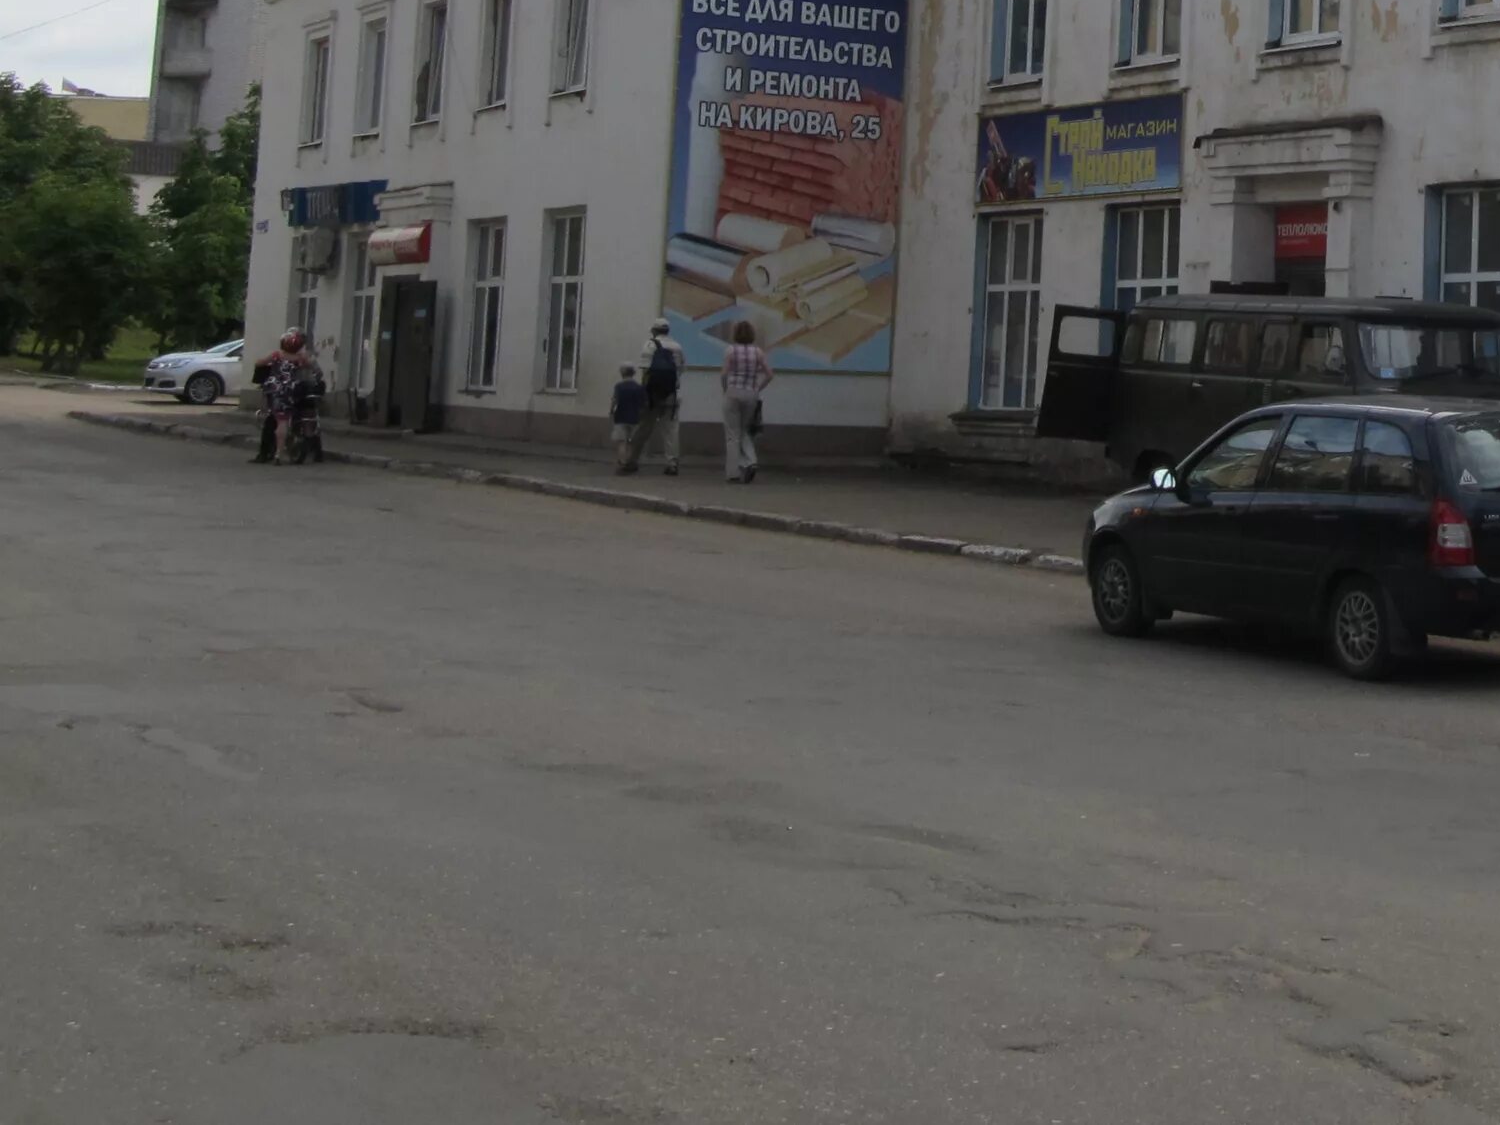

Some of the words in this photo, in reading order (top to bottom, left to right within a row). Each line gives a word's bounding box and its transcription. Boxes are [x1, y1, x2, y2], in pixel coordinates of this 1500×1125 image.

[800, 1, 900, 33] ВАШЕГО
[695, 27, 893, 69] СТРОИТЕЛЬСТВА
[724, 65, 743, 92] И
[748, 69, 862, 102] РЕМОНТА
[699, 101, 734, 129] НА
[739, 105, 845, 142] КИРОВА,
[851, 114, 882, 140] 25
[1105, 118, 1178, 141] МАГАЗИН
